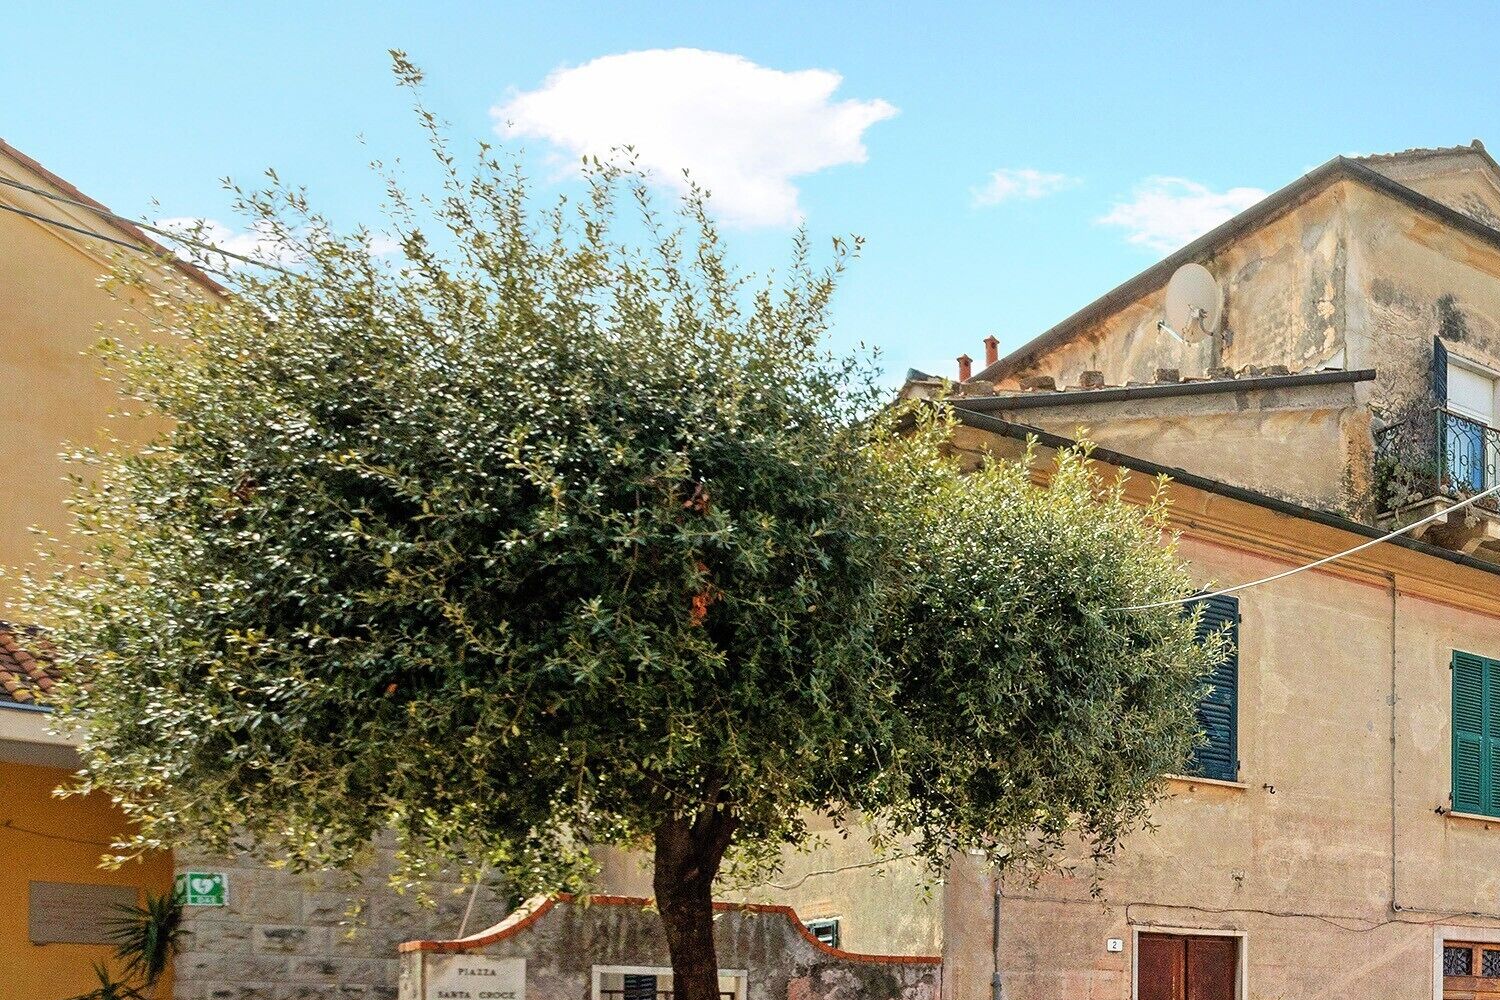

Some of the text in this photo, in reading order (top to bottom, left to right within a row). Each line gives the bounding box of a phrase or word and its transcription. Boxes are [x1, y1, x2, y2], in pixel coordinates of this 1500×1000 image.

[1112, 941, 1117, 949] 2
[458, 968, 497, 976] PIAZZA
[437, 991, 516, 1000] SANTA CROCE
